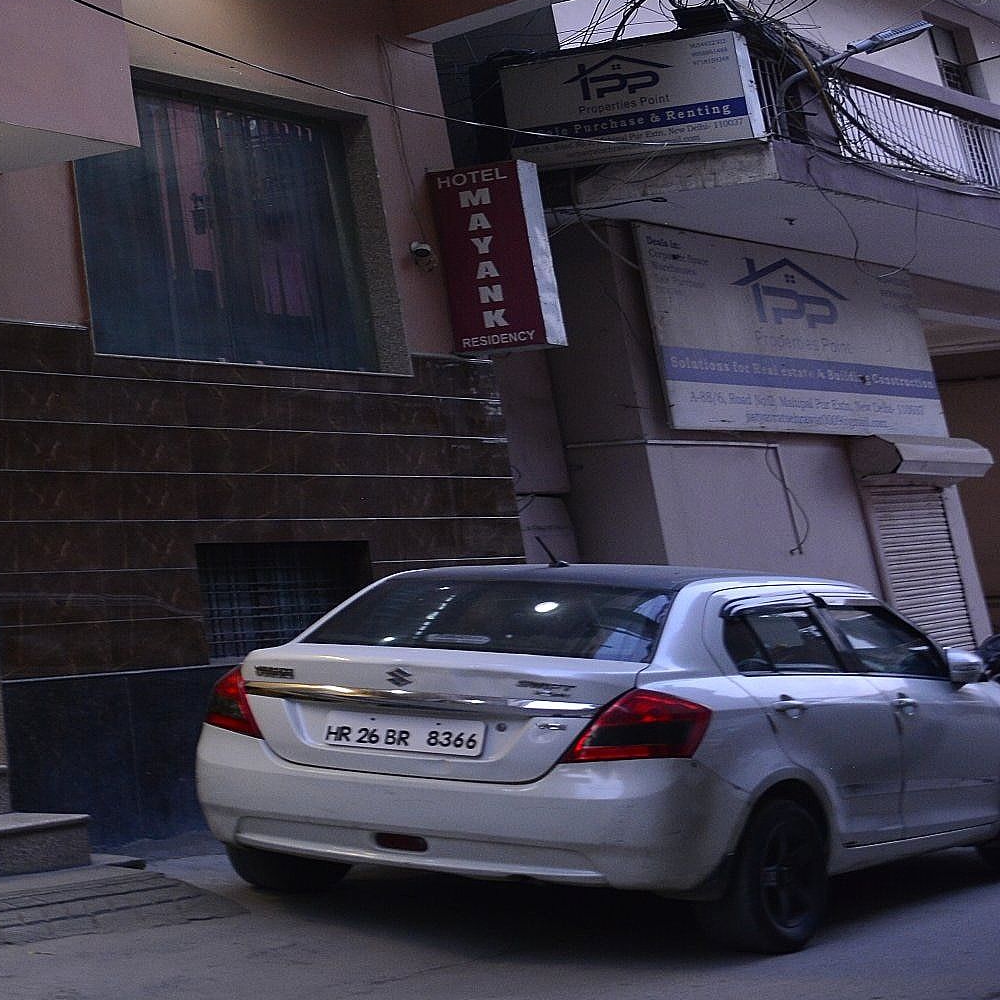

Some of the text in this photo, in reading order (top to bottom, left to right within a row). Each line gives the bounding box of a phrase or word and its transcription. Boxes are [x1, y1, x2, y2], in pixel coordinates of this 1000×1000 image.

[578, 94, 670, 114] Properties Point
[574, 116, 644, 134] Purchase
[650, 113, 660, 123] &
[665, 104, 732, 121] Renting
[437, 167, 508, 189] HOTEL
[458, 187, 510, 329] MAYANK
[462, 329, 536, 348] RESIDENCY
[325, 726, 477, 749] HR 26 BR 8366
